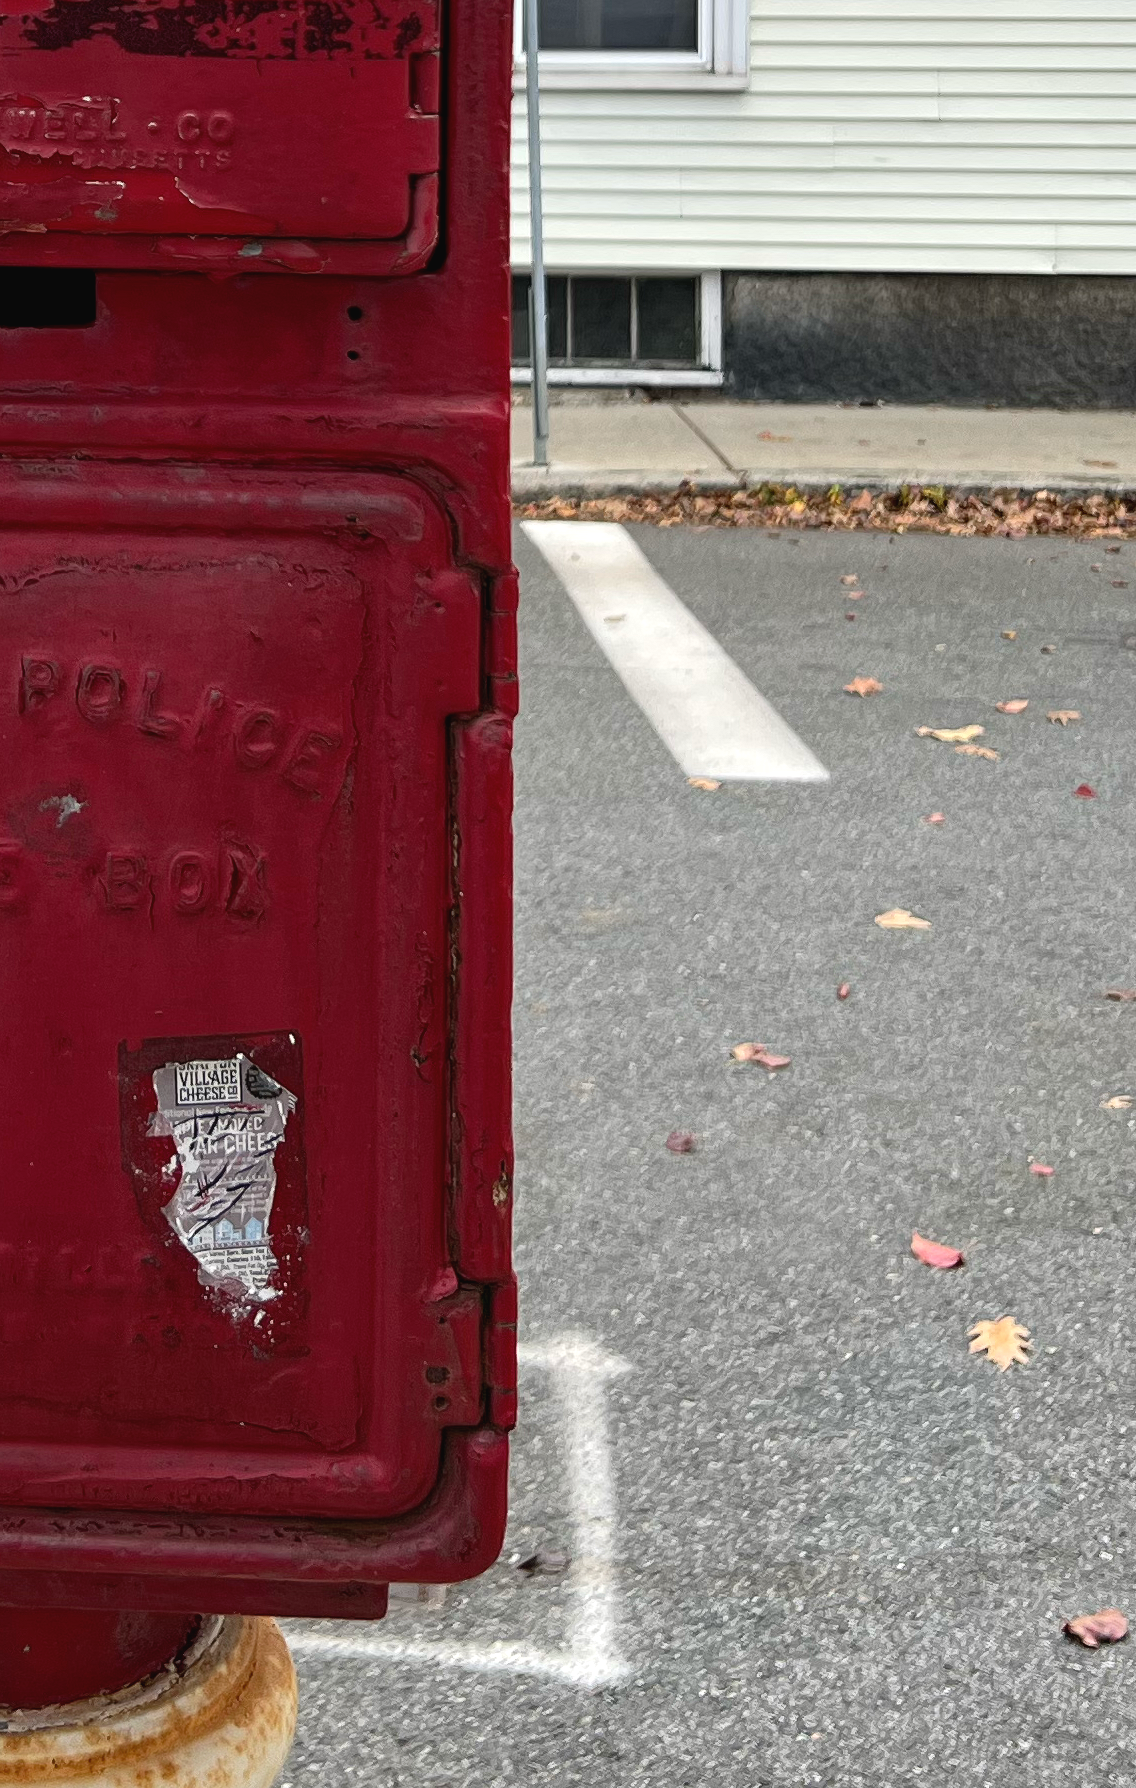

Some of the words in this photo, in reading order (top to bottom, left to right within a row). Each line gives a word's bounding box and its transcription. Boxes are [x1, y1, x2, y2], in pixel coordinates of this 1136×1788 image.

[20, 655, 338, 800] POLICE
[105, 832, 266, 914] BOX
[179, 1069, 238, 1086] VILLAGE
[179, 1086, 226, 1102] CHEESE
